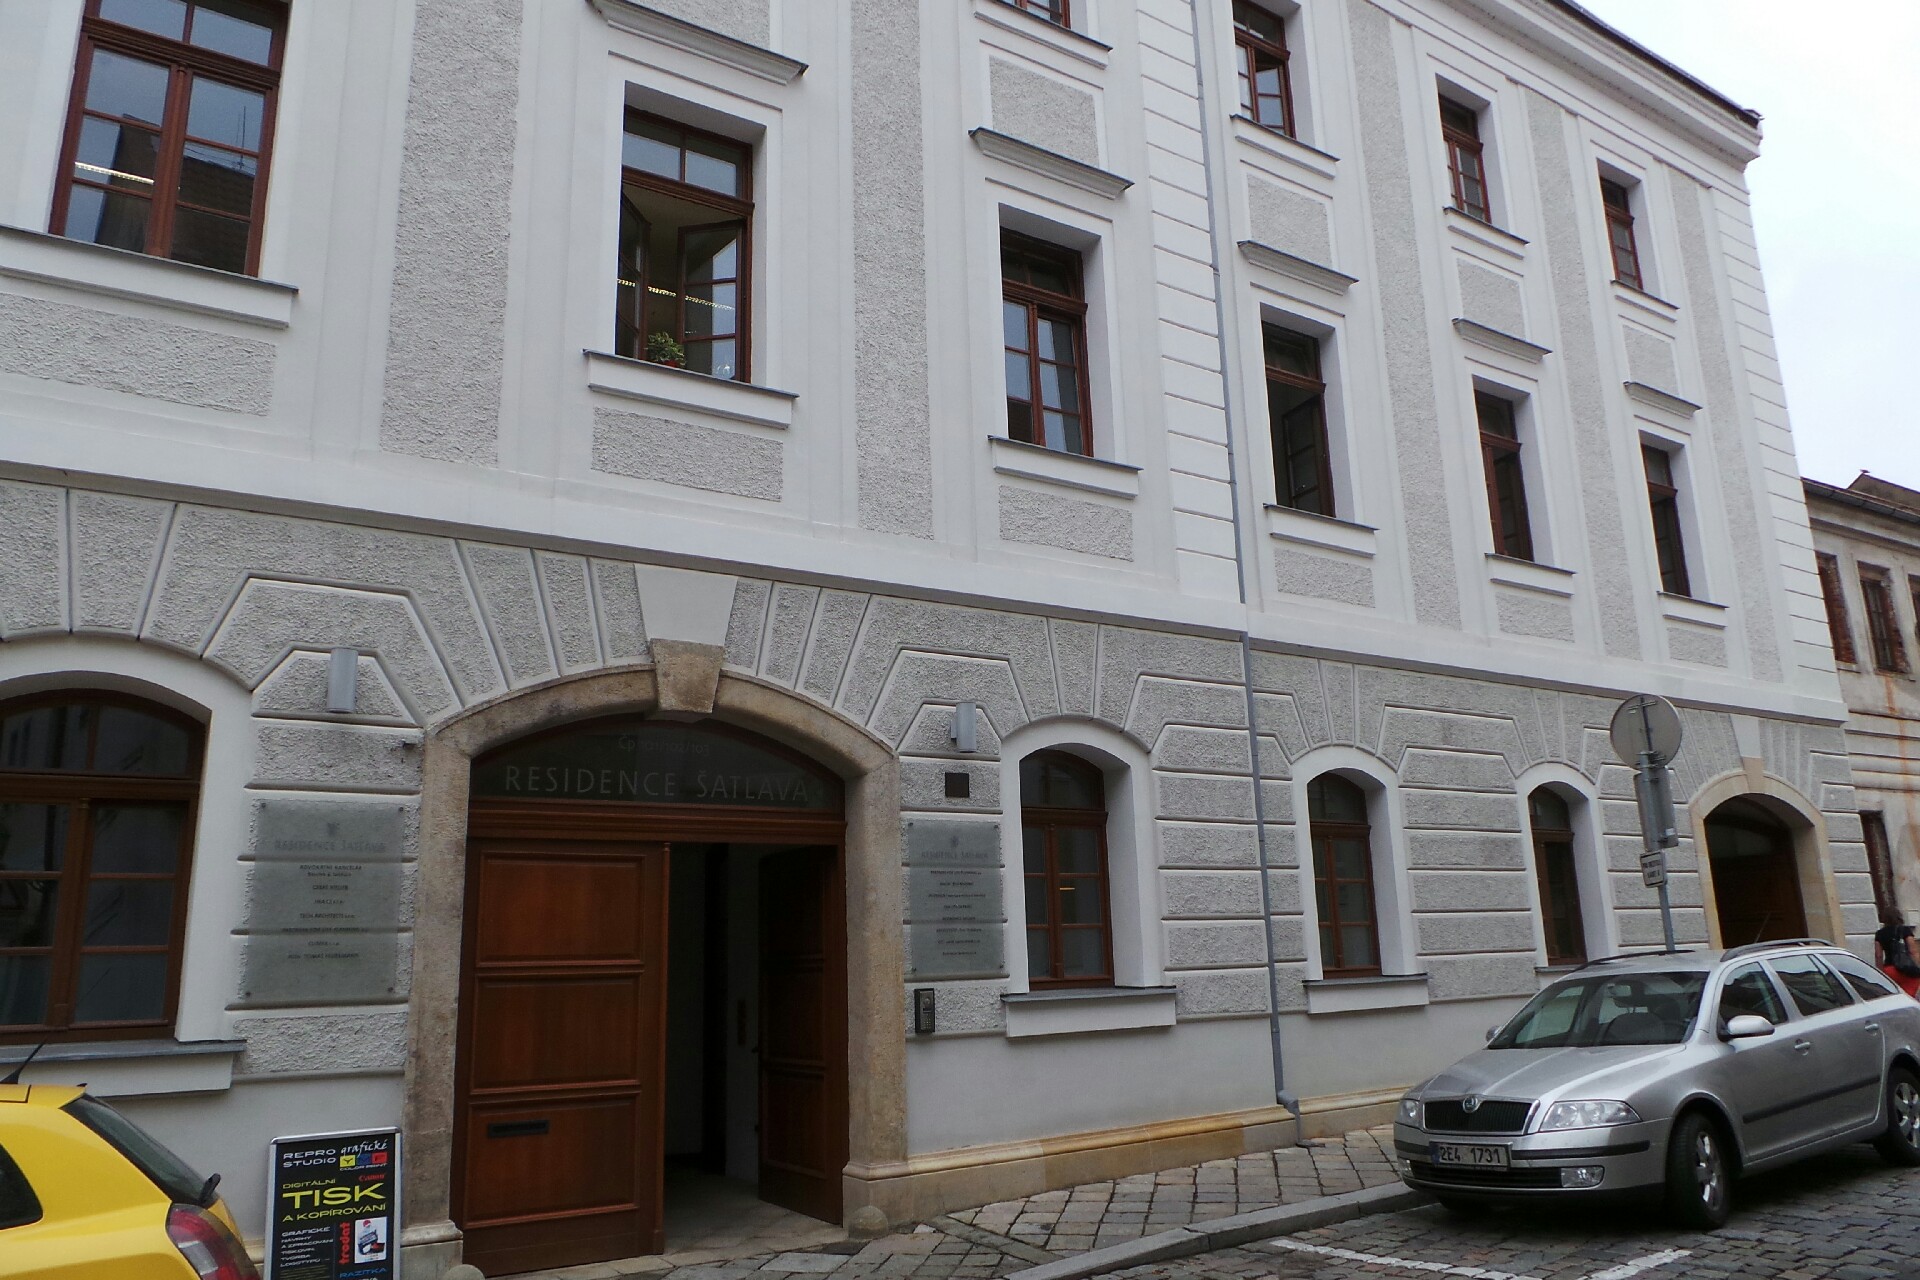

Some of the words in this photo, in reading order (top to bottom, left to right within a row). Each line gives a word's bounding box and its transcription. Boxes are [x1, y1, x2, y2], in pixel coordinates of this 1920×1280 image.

[505, 765, 676, 797] RESIDENCE
[697, 770, 808, 802] ŠATLAVA
[283, 1149, 336, 1160] REPRO
[340, 1139, 388, 1157] grafické
[1440, 1146, 1461, 1162] 2E4
[1470, 1148, 1501, 1164] 1731
[283, 1157, 337, 1168] STUDIO
[282, 1182, 386, 1209] TISK
